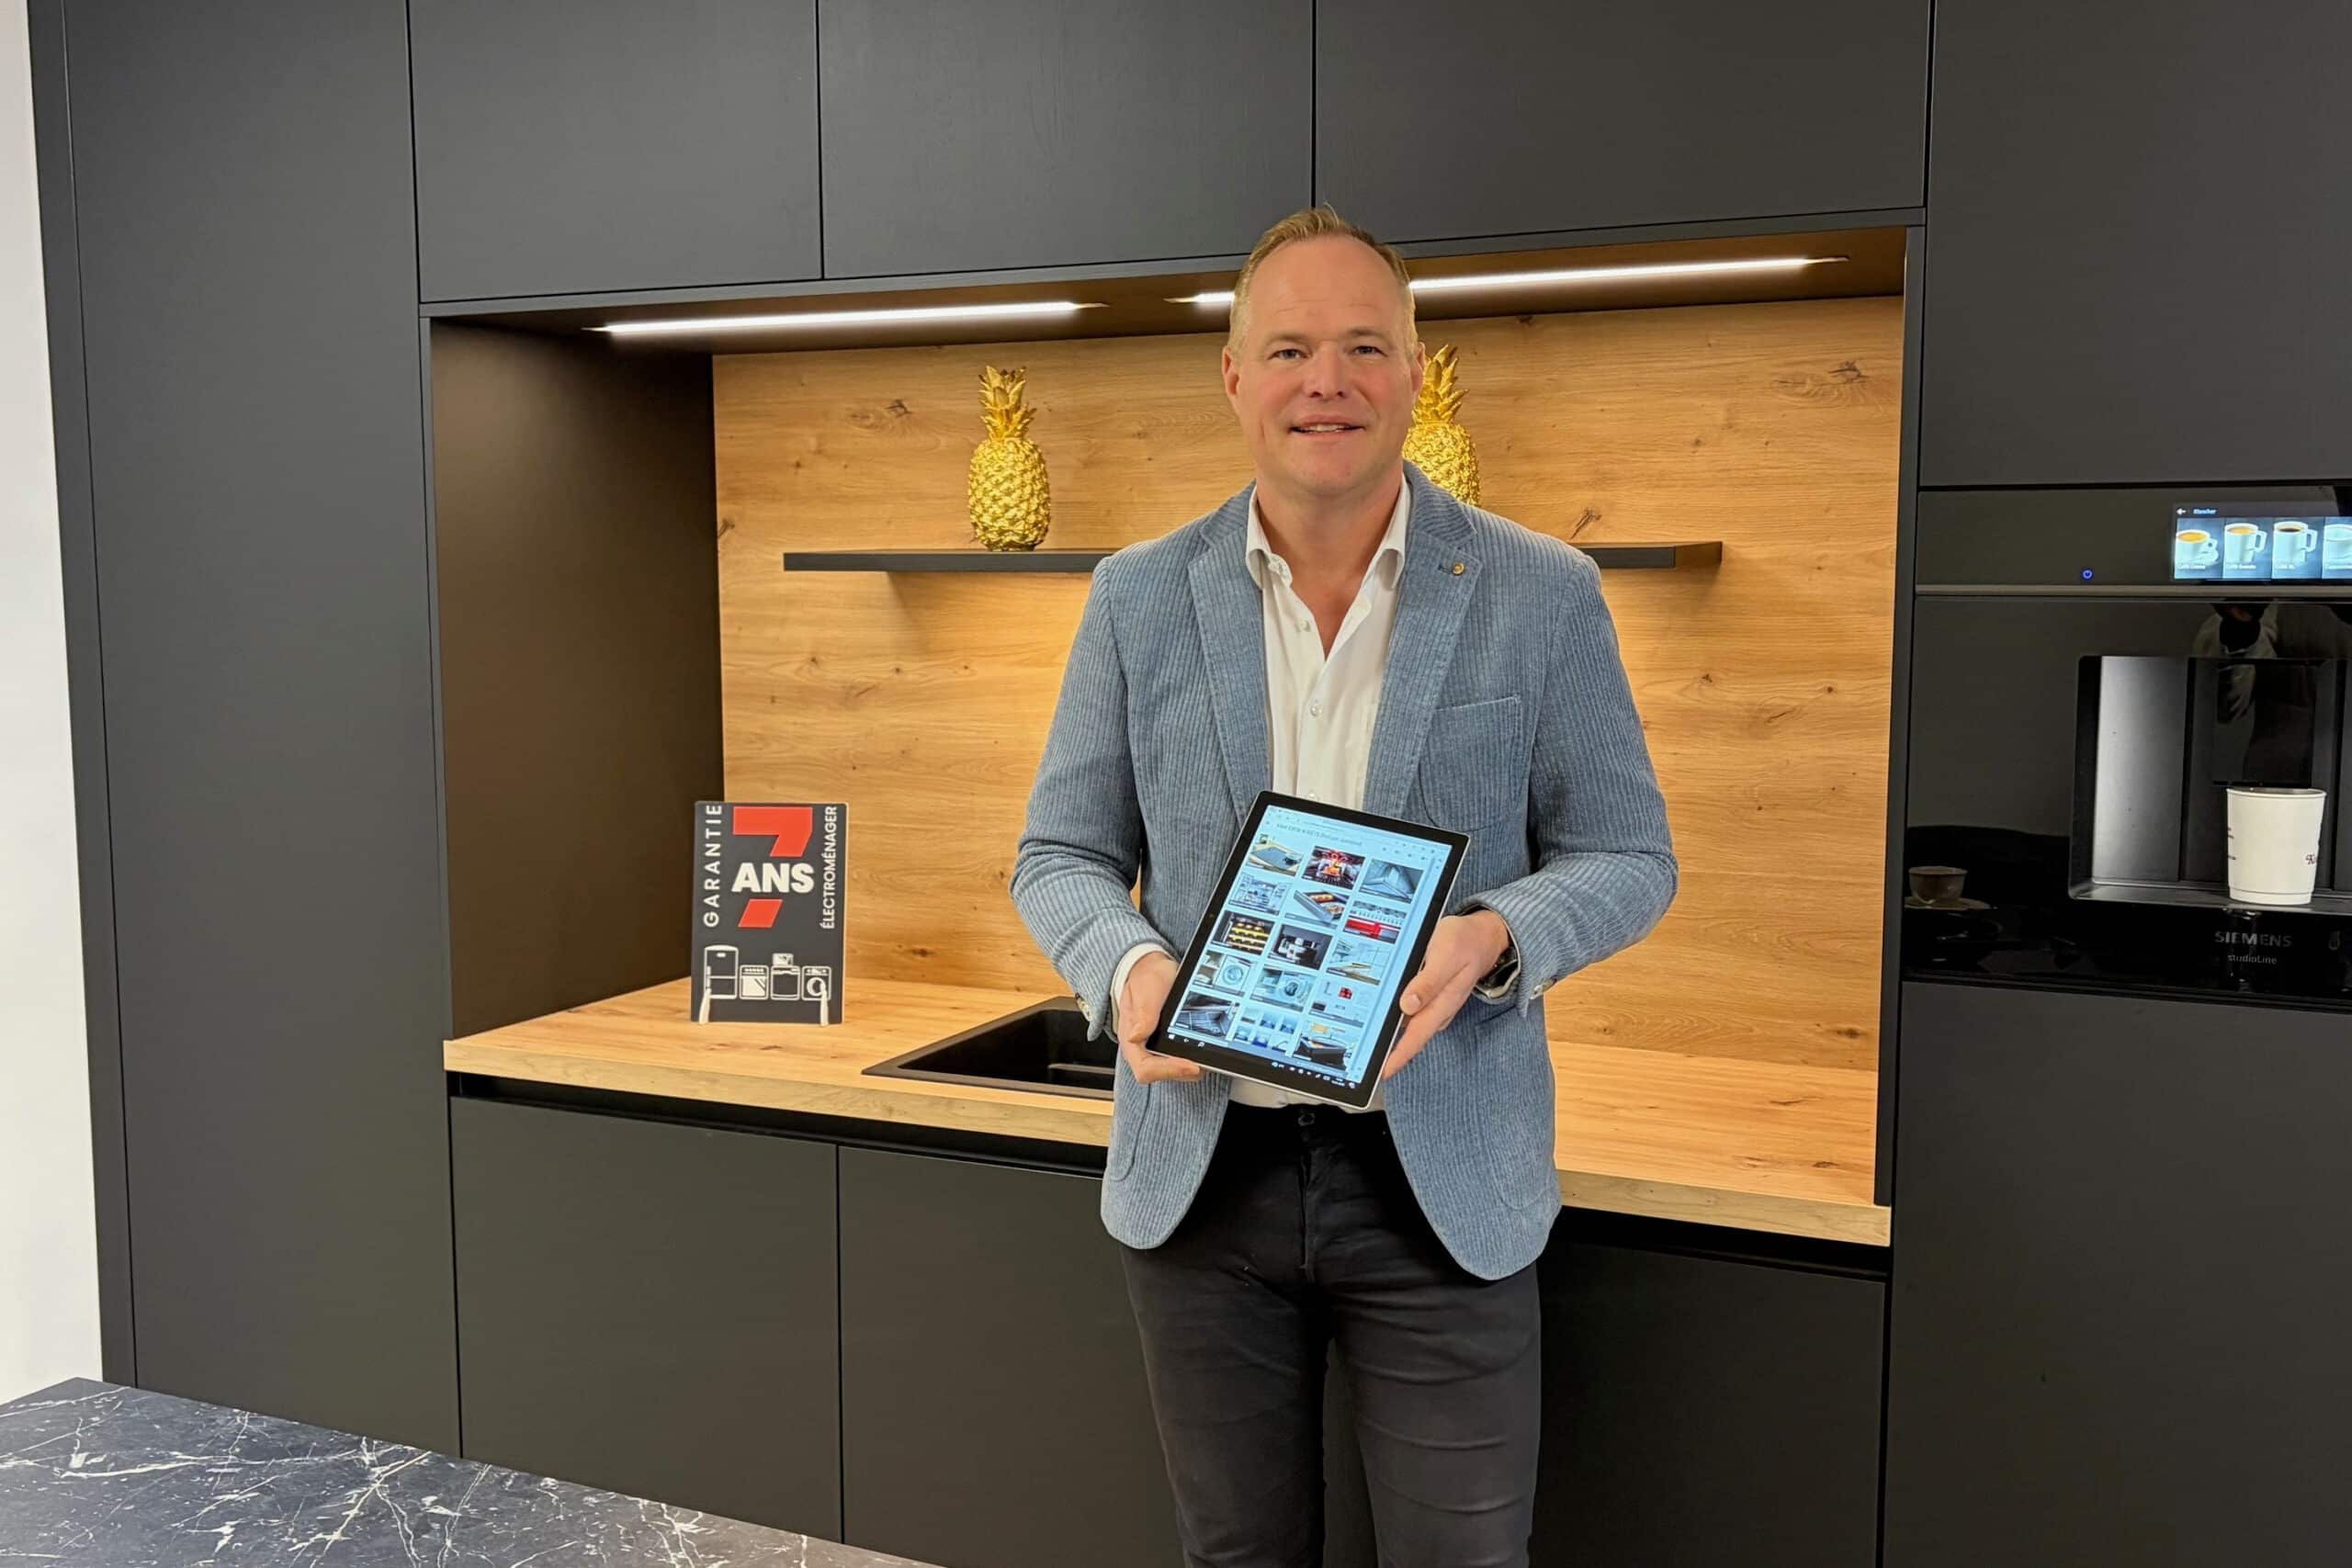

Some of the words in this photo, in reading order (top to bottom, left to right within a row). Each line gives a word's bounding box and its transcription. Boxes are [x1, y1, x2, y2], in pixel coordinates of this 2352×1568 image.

[703, 805, 722, 928] GARANTIE
[730, 862, 815, 894] ANS
[732, 807, 813, 928] 7
[820, 806, 837, 930] ÉLECTROMÉNAGER
[2214, 931, 2293, 947] SIEMENS
